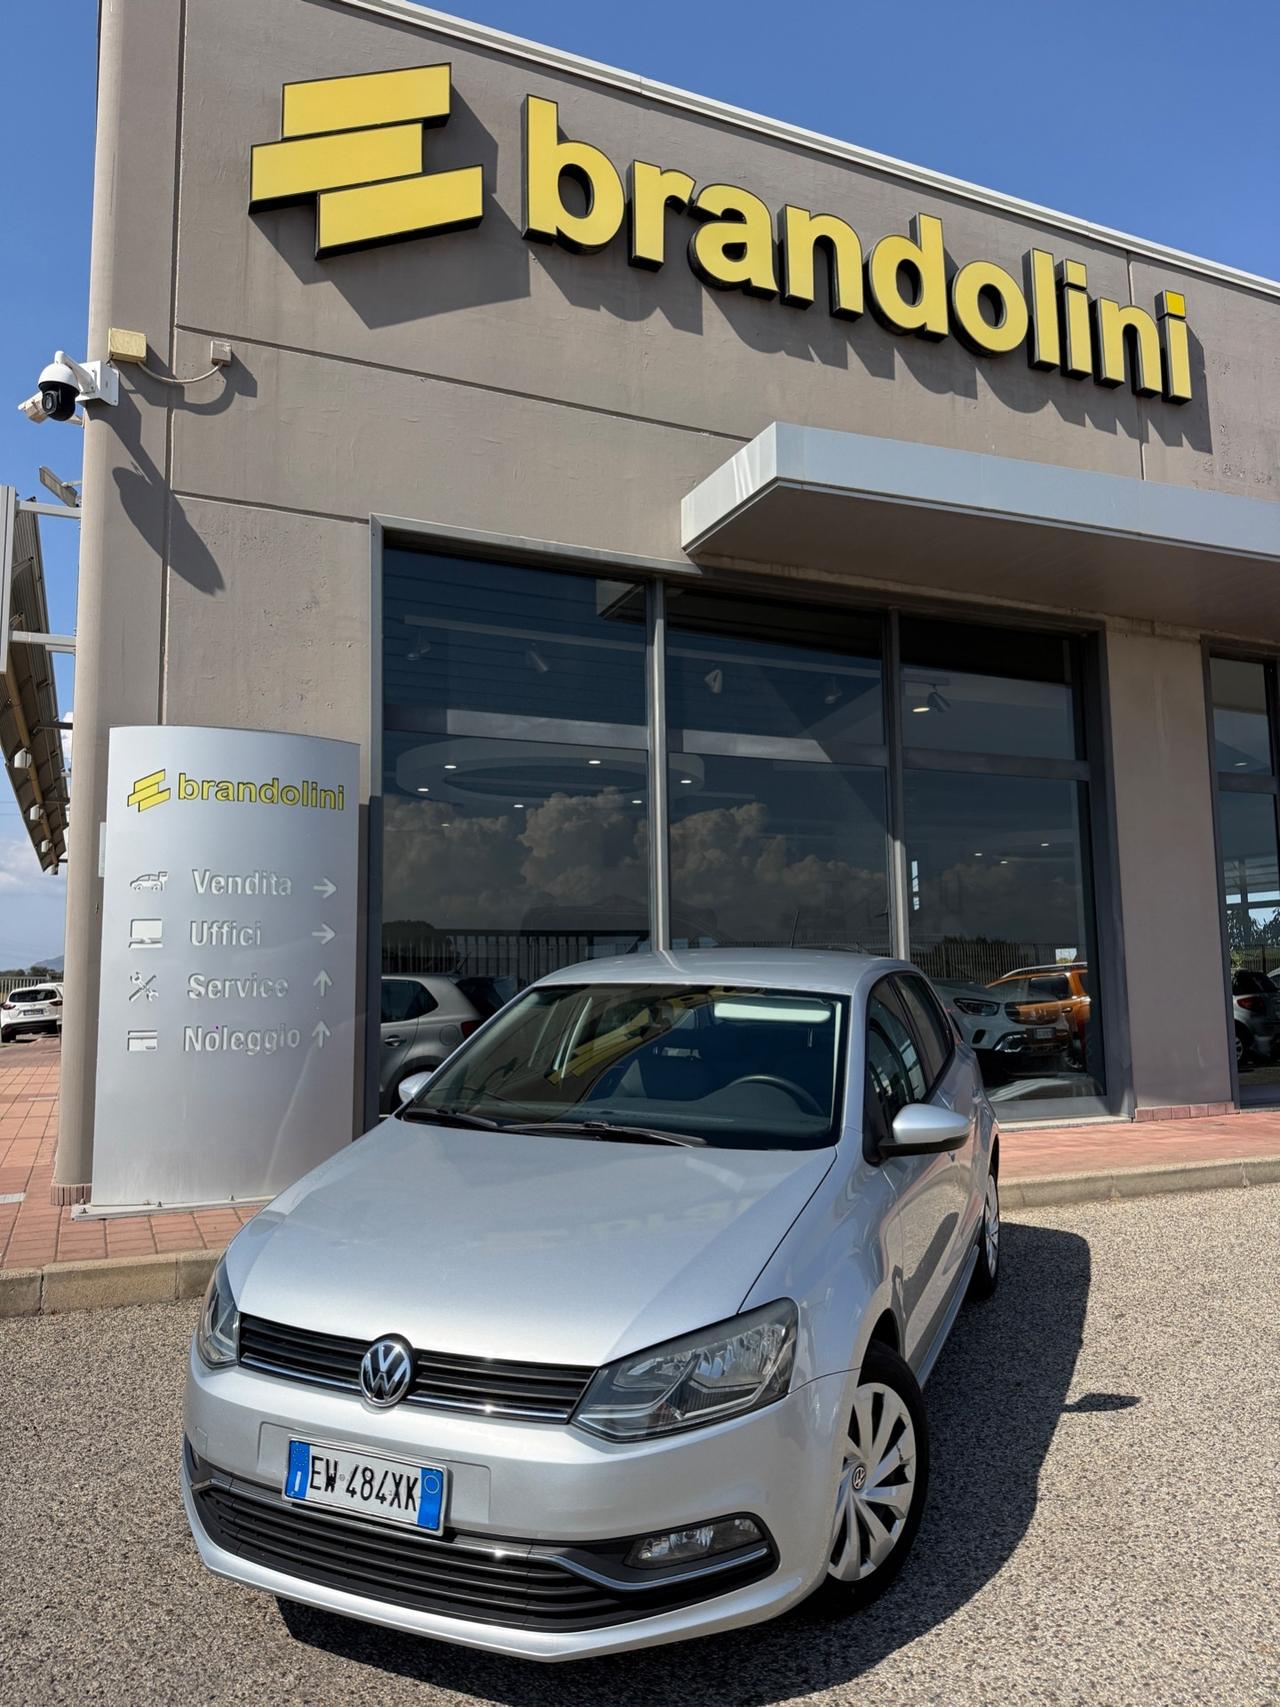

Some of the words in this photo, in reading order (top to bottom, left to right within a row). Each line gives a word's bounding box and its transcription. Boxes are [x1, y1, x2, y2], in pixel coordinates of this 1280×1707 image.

[522, 93, 1192, 404] brandolini
[177, 773, 345, 811] brandolini
[192, 869, 292, 896] Vendita
[189, 920, 262, 946] Uffici
[187, 973, 289, 1000] Service
[184, 1024, 300, 1055] Noleggio
[361, 1341, 411, 1408] VW
